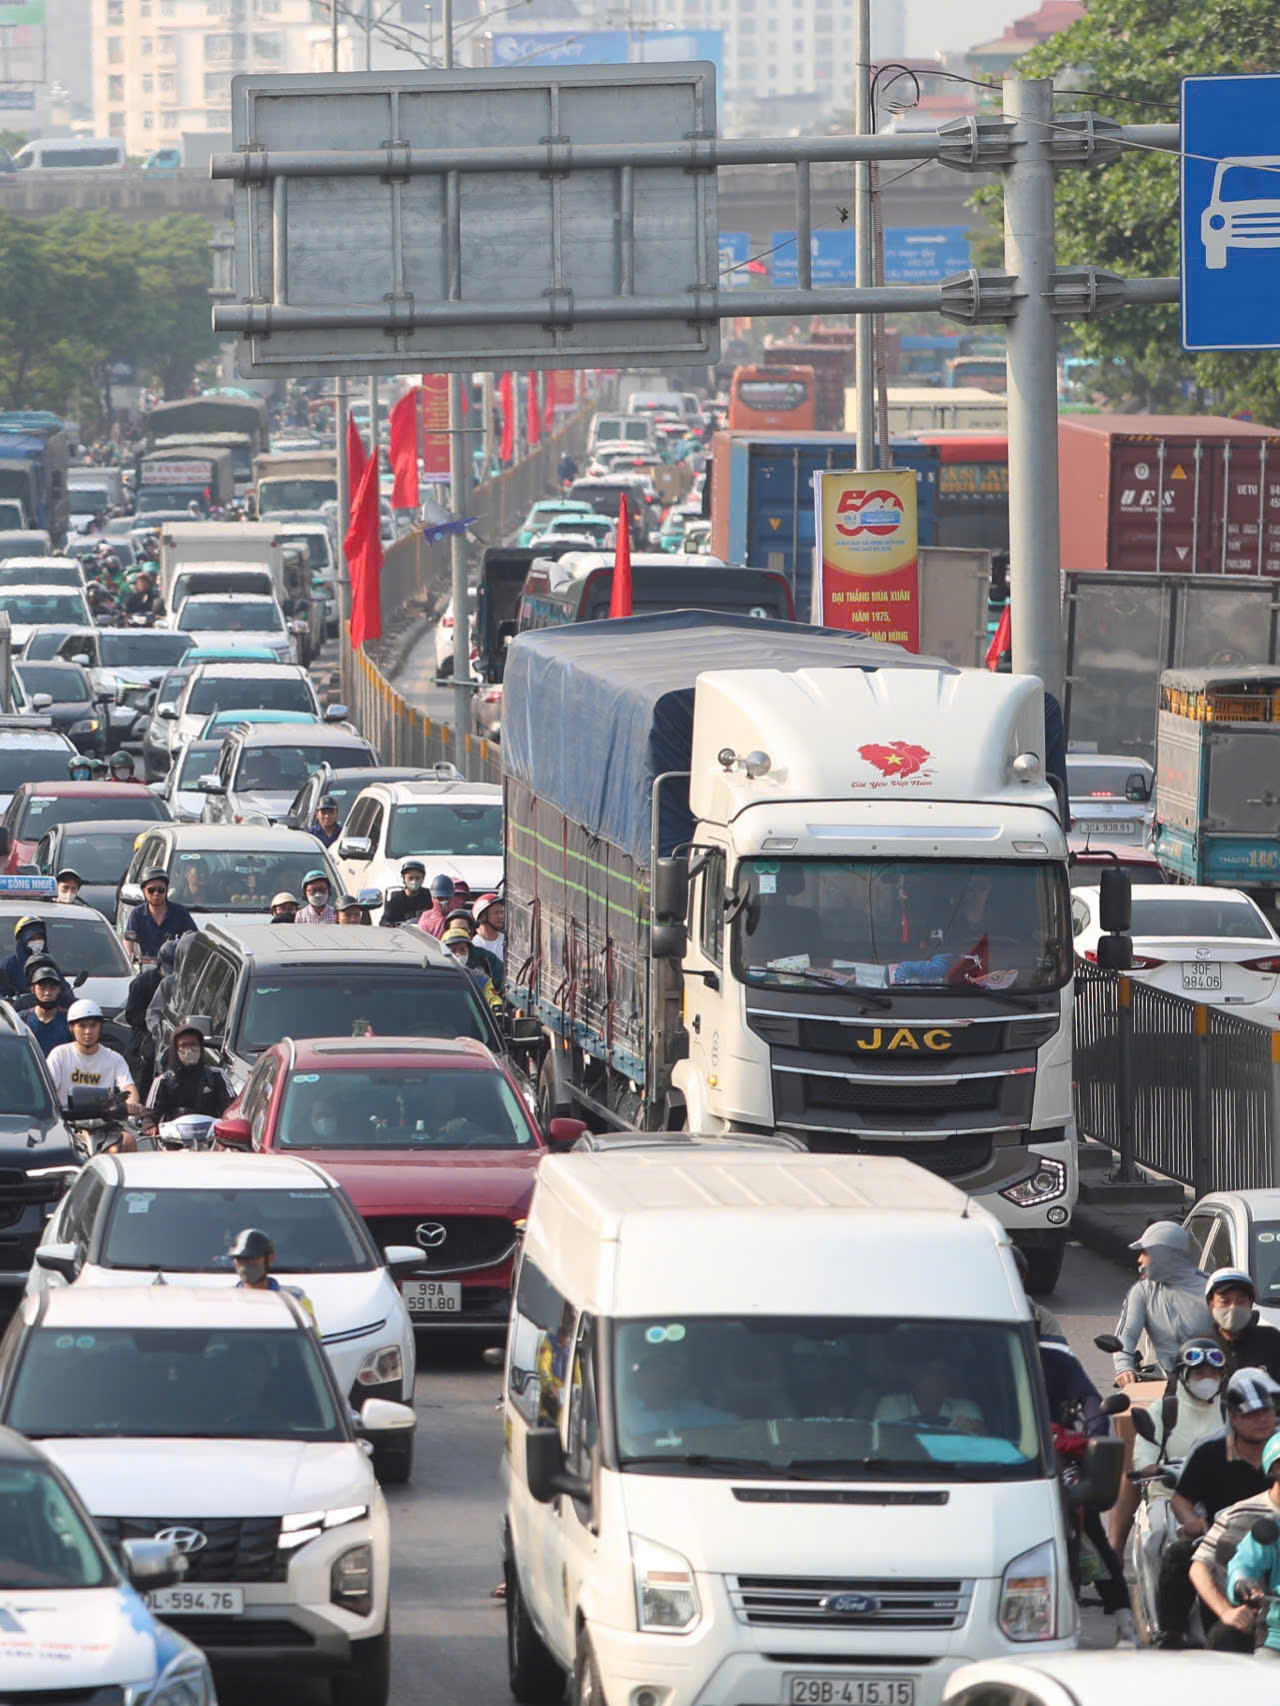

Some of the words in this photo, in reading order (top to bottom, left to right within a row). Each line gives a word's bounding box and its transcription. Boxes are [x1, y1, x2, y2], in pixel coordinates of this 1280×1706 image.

[1192, 963, 1211, 975] 30F
[1184, 976, 1220, 987] 984.06
[856, 1028, 952, 1050] JAC
[72, 1069, 101, 1084] drew
[419, 1283, 444, 1296] 99A
[408, 1297, 455, 1310] 591.80
[795, 1681, 910, 1705] 29B-415.15
